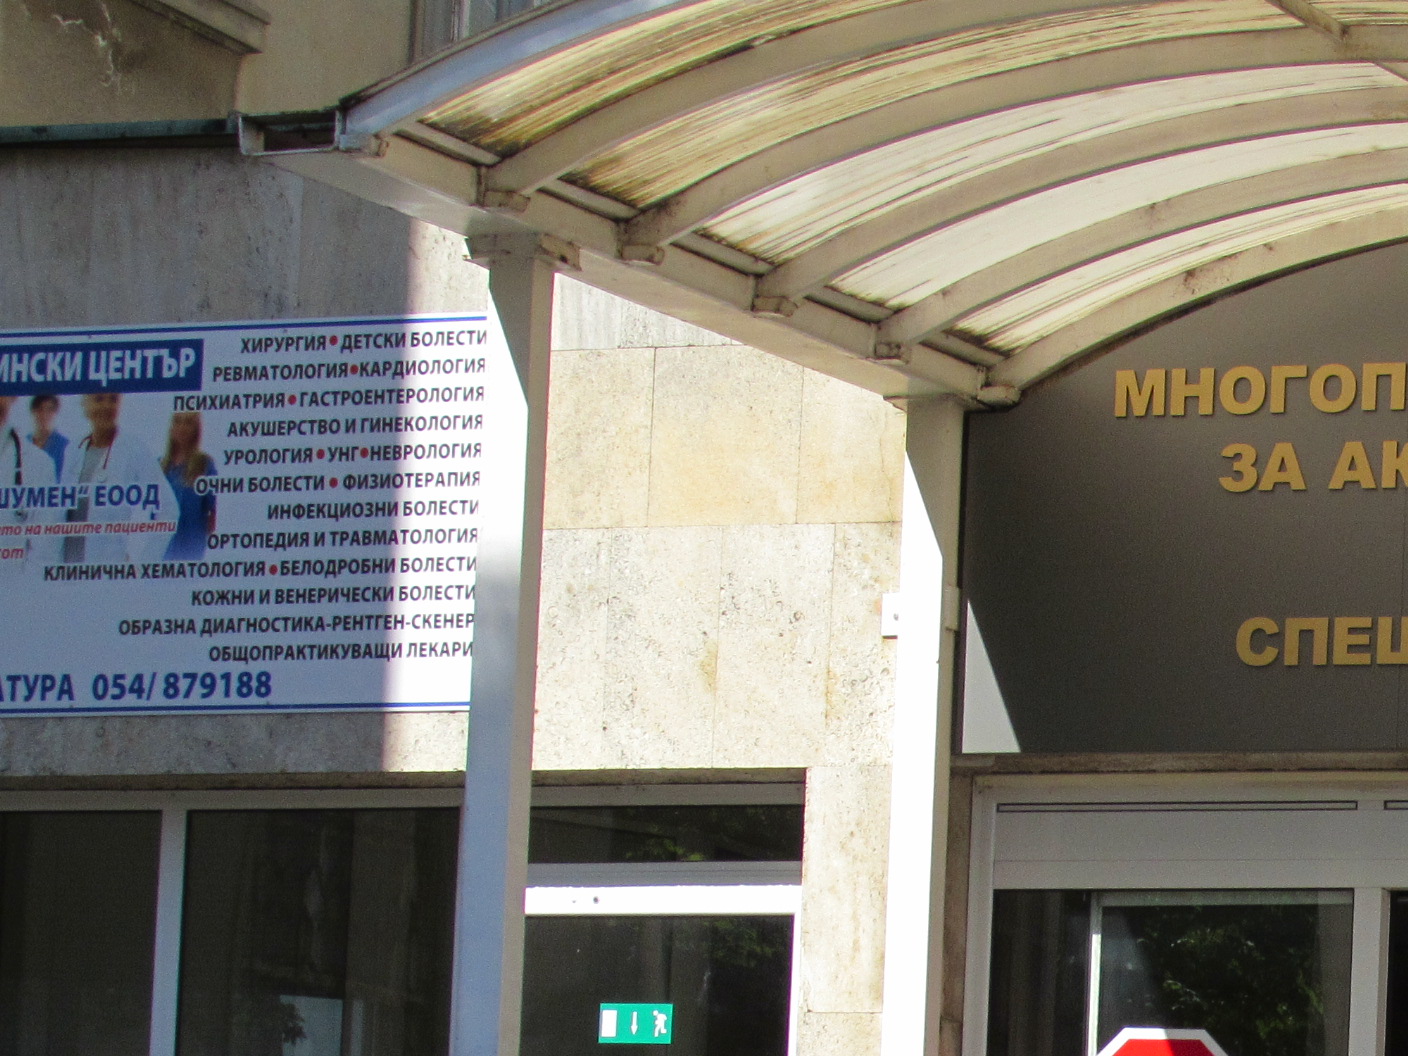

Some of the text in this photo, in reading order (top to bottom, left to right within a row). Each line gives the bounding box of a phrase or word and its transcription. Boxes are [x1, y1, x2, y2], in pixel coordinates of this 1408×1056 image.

[241, 329, 487, 353] ХИРУРГИЯ ДЕТСКИ БОЛЕСТИ
[88, 347, 196, 388] ЦЕНТЪР
[213, 357, 486, 382] РЕВМАТОЛОГИЯ КАРДИОЛОГИЯ
[173, 386, 484, 412] ПСИХИАТРИЯ ГАСТРОЕНТЕРОЛОГИЯ
[227, 414, 483, 437] АКУШЕРСТВО И ГИНЕКОЛОГИЯ
[224, 442, 482, 466] УРОЛОГИЯ УНГ НЕВРОЛОГИЯ
[1218, 441, 1306, 493] ЗА
[195, 471, 480, 495] ОЧНИ БОЛЕСТИ ФИЗИОТЕРАПИЯ
[95, 484, 161, 511] ЕООД
[268, 499, 479, 522] ИНФЕКЦИОЗНИ БОЛЕСТИ
[25, 525, 42, 536] на
[45, 522, 102, 536] нашите
[104, 520, 177, 536] пациенти
[208, 527, 478, 551] ОРТОПЕДИЯ И ТРАВМАТОЛОГИЯ
[44, 556, 477, 581] КЛИНИЧНА ХЕМАТОЛОГИЯ БЕЛОДРОБНИ БОЛЕСТИ
[192, 584, 476, 606] КОЖНИ И ВЕНЕРИЧЕСКИ БОЛЕСТИ
[119, 619, 196, 635] ОБРАЗНА
[209, 641, 473, 663] ОБЩОПРАКТИКУВАЩИ ЛЕКАРИ
[0, 671, 272, 702] ТУРА 054/ 879188
